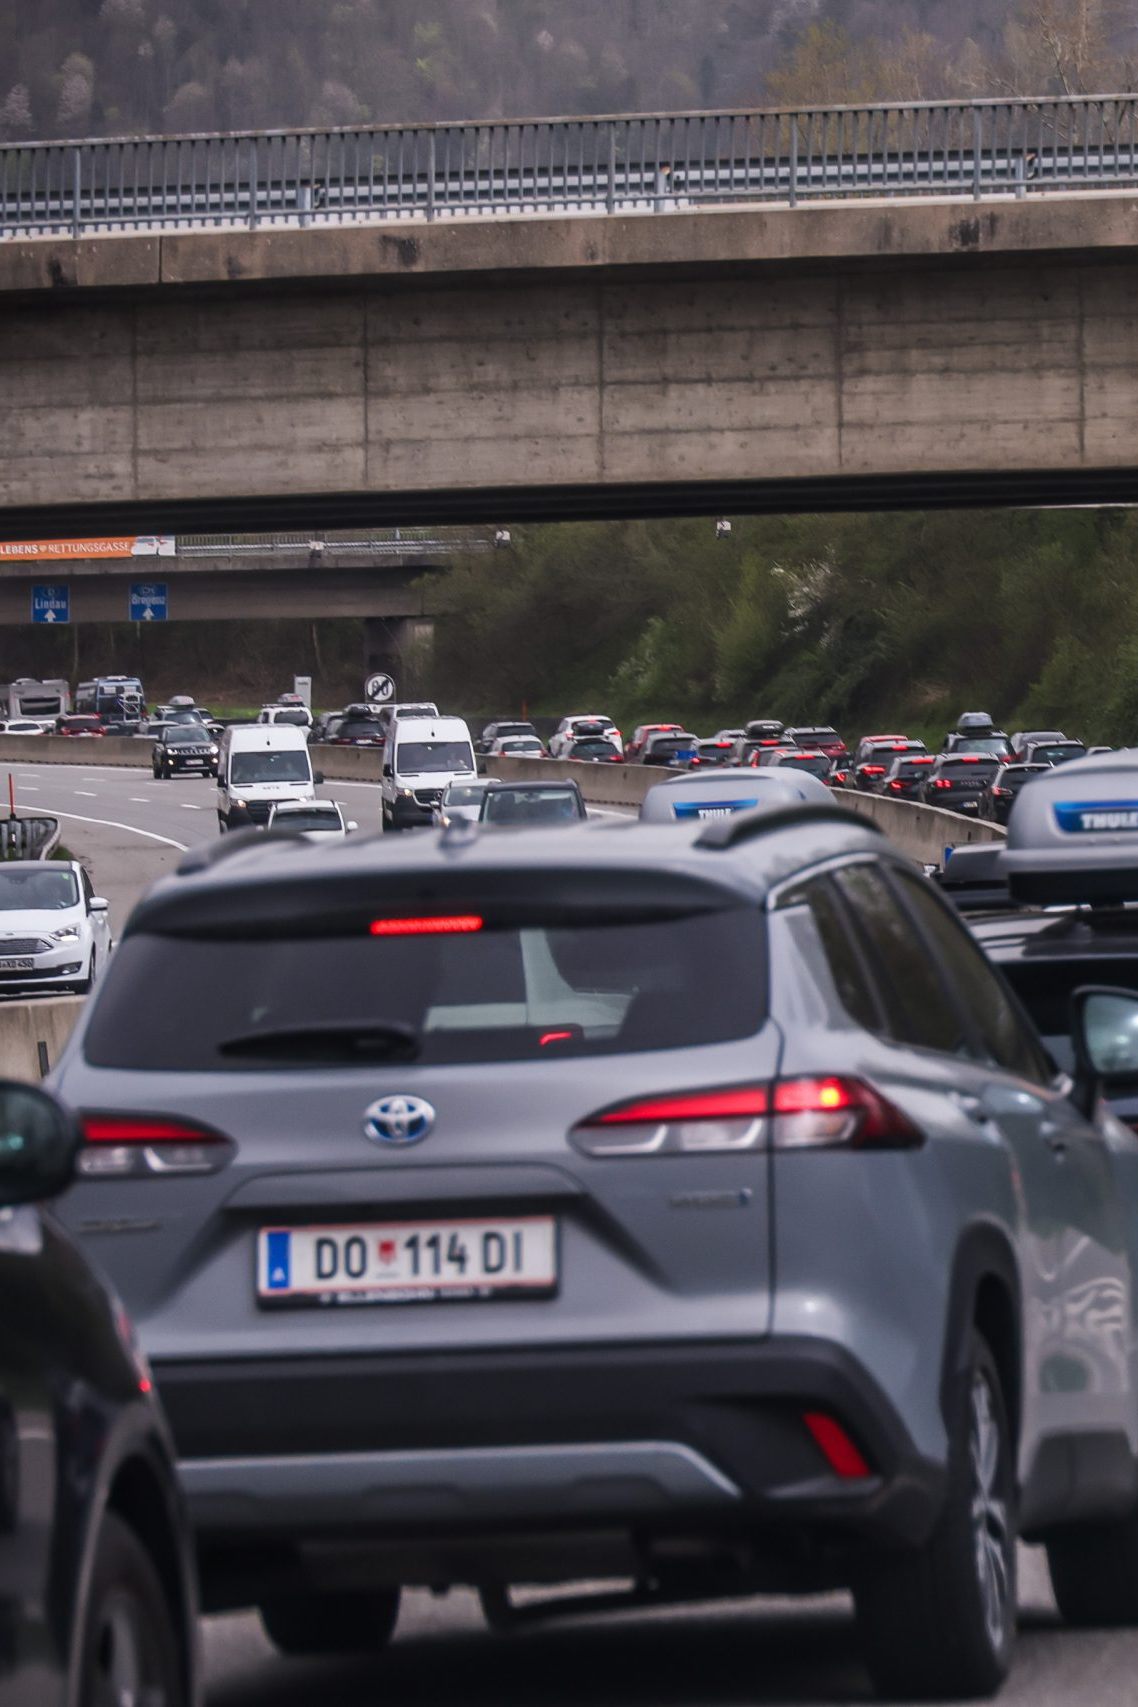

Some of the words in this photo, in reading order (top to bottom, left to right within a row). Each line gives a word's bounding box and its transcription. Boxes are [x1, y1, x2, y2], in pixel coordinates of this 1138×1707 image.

[314, 1237, 368, 1280] DO
[403, 1232, 468, 1277] 114
[481, 1231, 523, 1274] DI
